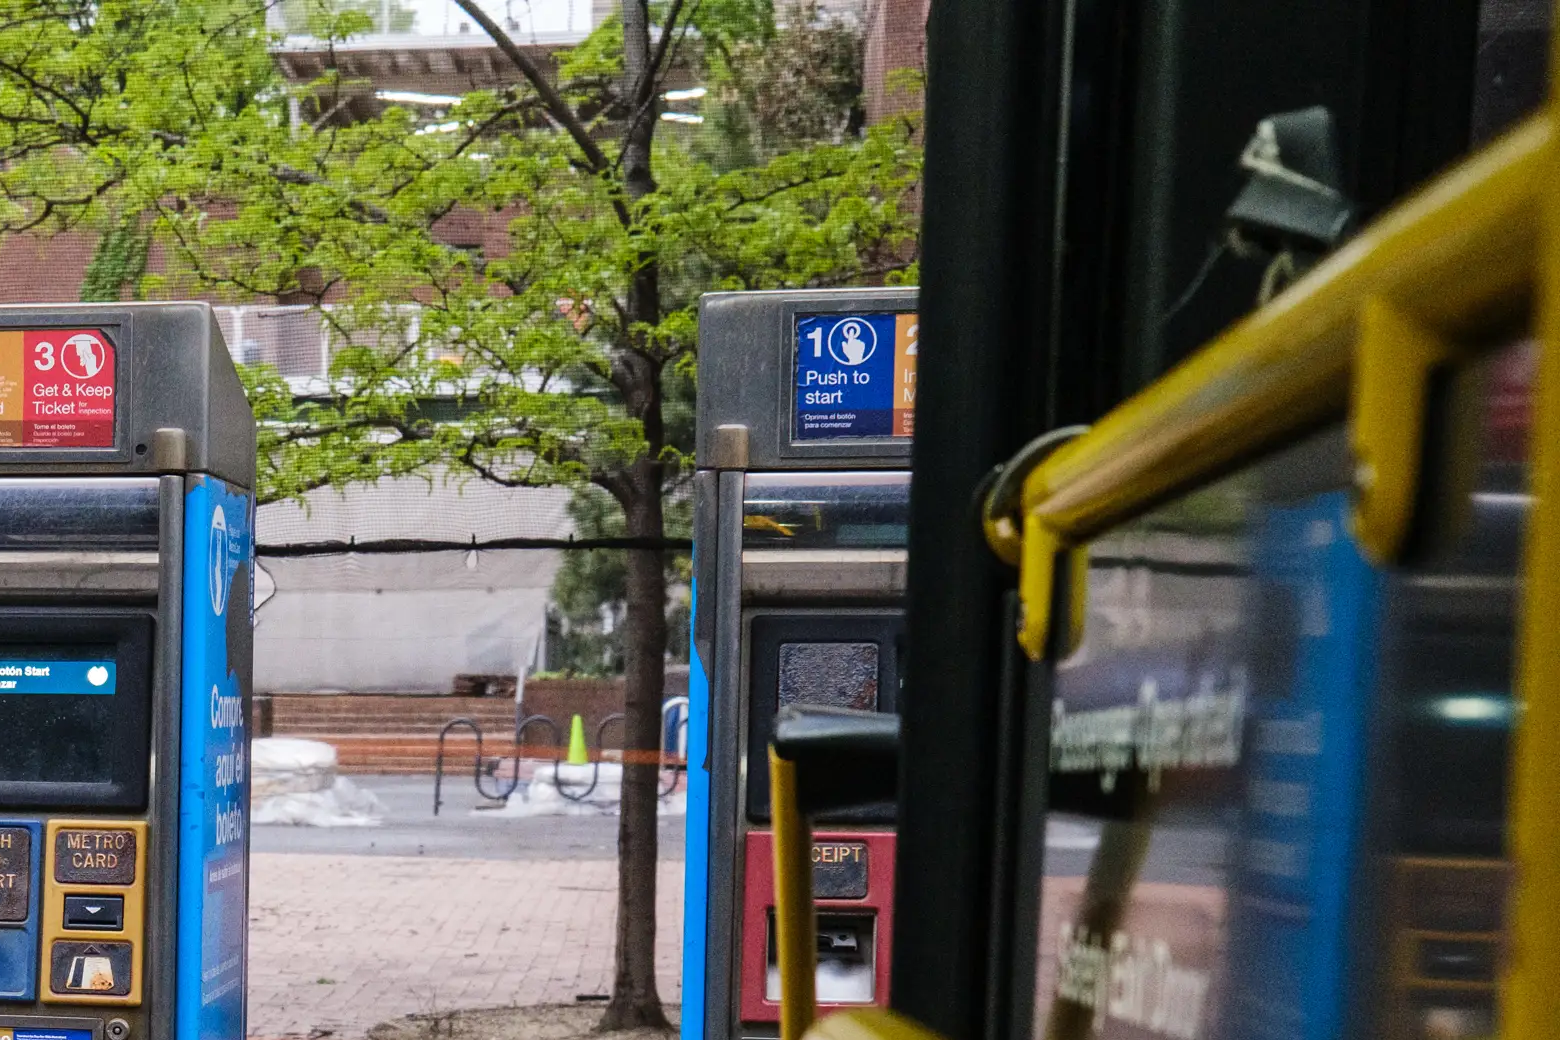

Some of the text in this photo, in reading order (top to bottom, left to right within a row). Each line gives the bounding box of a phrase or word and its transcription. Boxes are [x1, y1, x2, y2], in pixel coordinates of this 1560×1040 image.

[807, 326, 823, 358] 1
[34, 341, 55, 371] 3
[806, 370, 870, 385] Push to
[33, 383, 113, 400] Get & Keep
[805, 390, 843, 404] start
[32, 401, 75, 416] Ticket
[78, 408, 112, 416] inspection
[805, 413, 829, 421] Oprima
[837, 412, 856, 420] botón
[25, 666, 50, 677] Start
[67, 833, 126, 850] METRO
[72, 853, 118, 869] CARD
[811, 846, 863, 863] CEIPT
